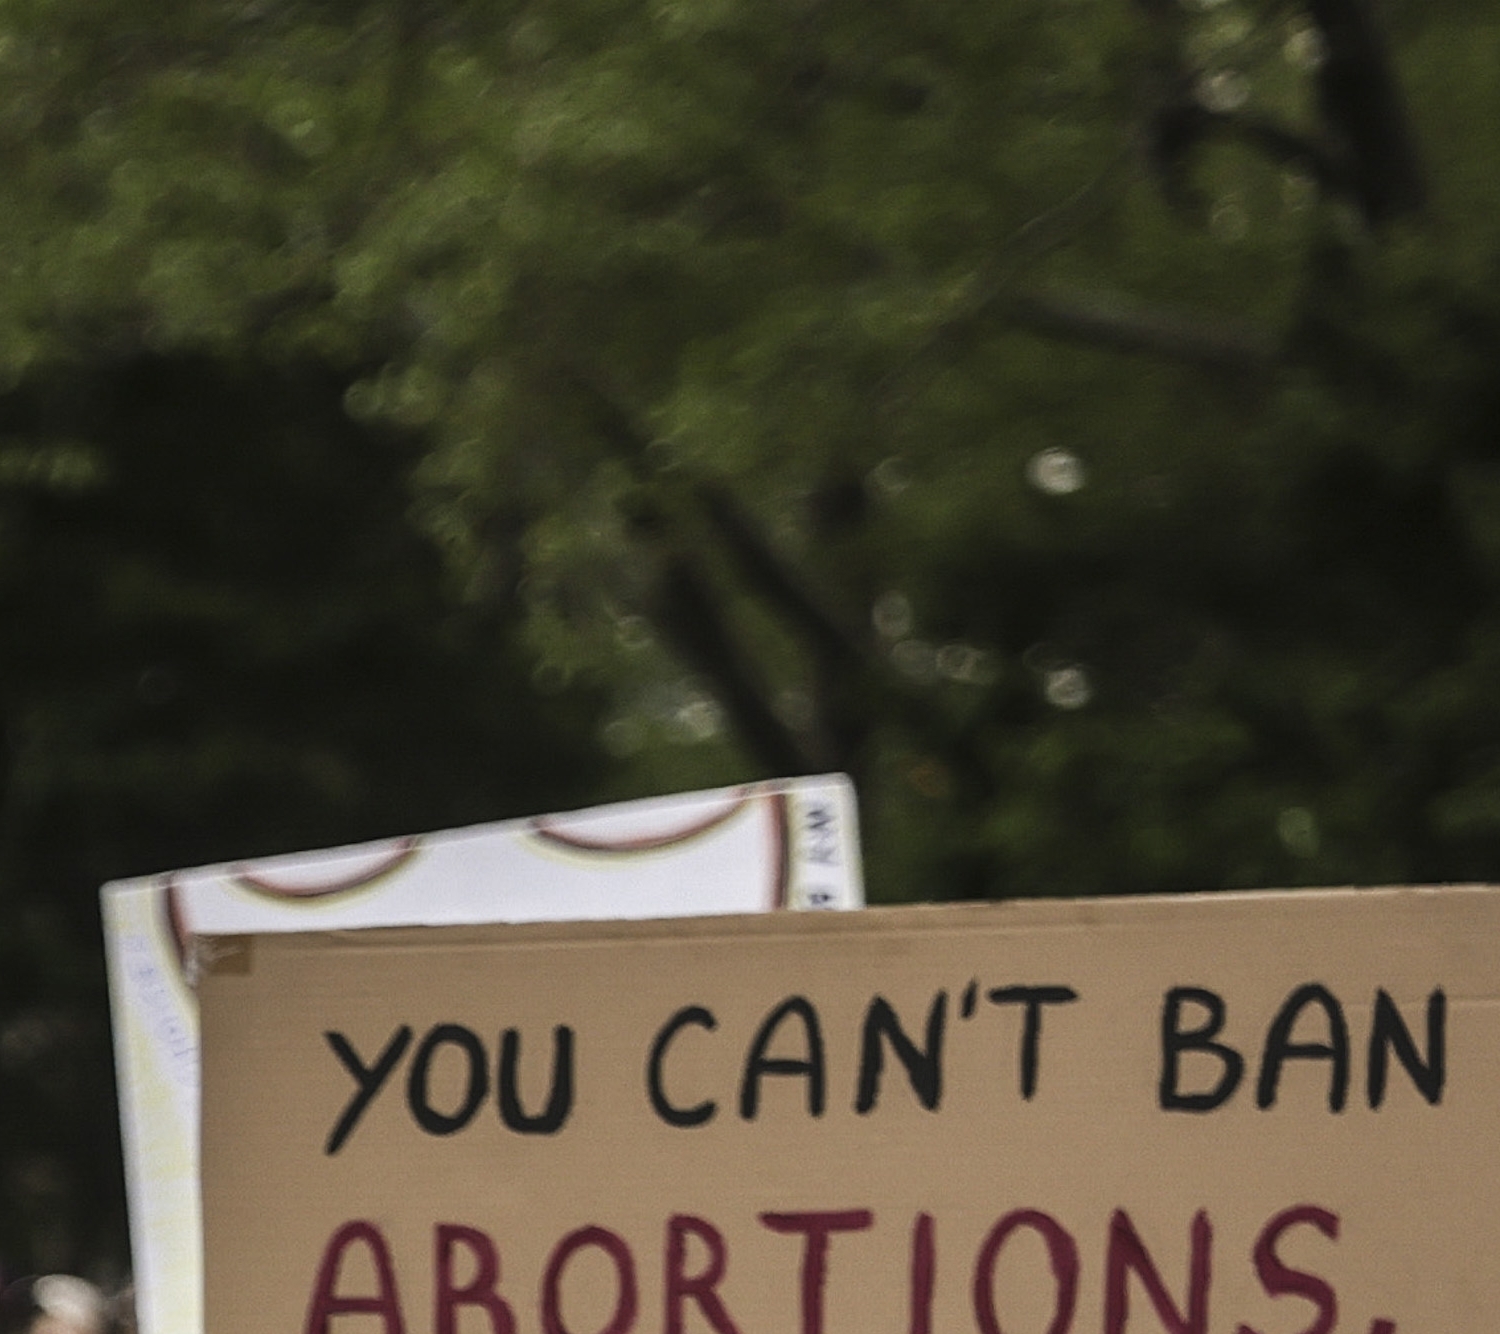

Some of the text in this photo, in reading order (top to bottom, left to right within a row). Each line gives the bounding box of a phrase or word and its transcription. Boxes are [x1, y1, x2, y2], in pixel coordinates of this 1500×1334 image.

[322, 978, 1447, 1155] YOU CAN'T BAN
